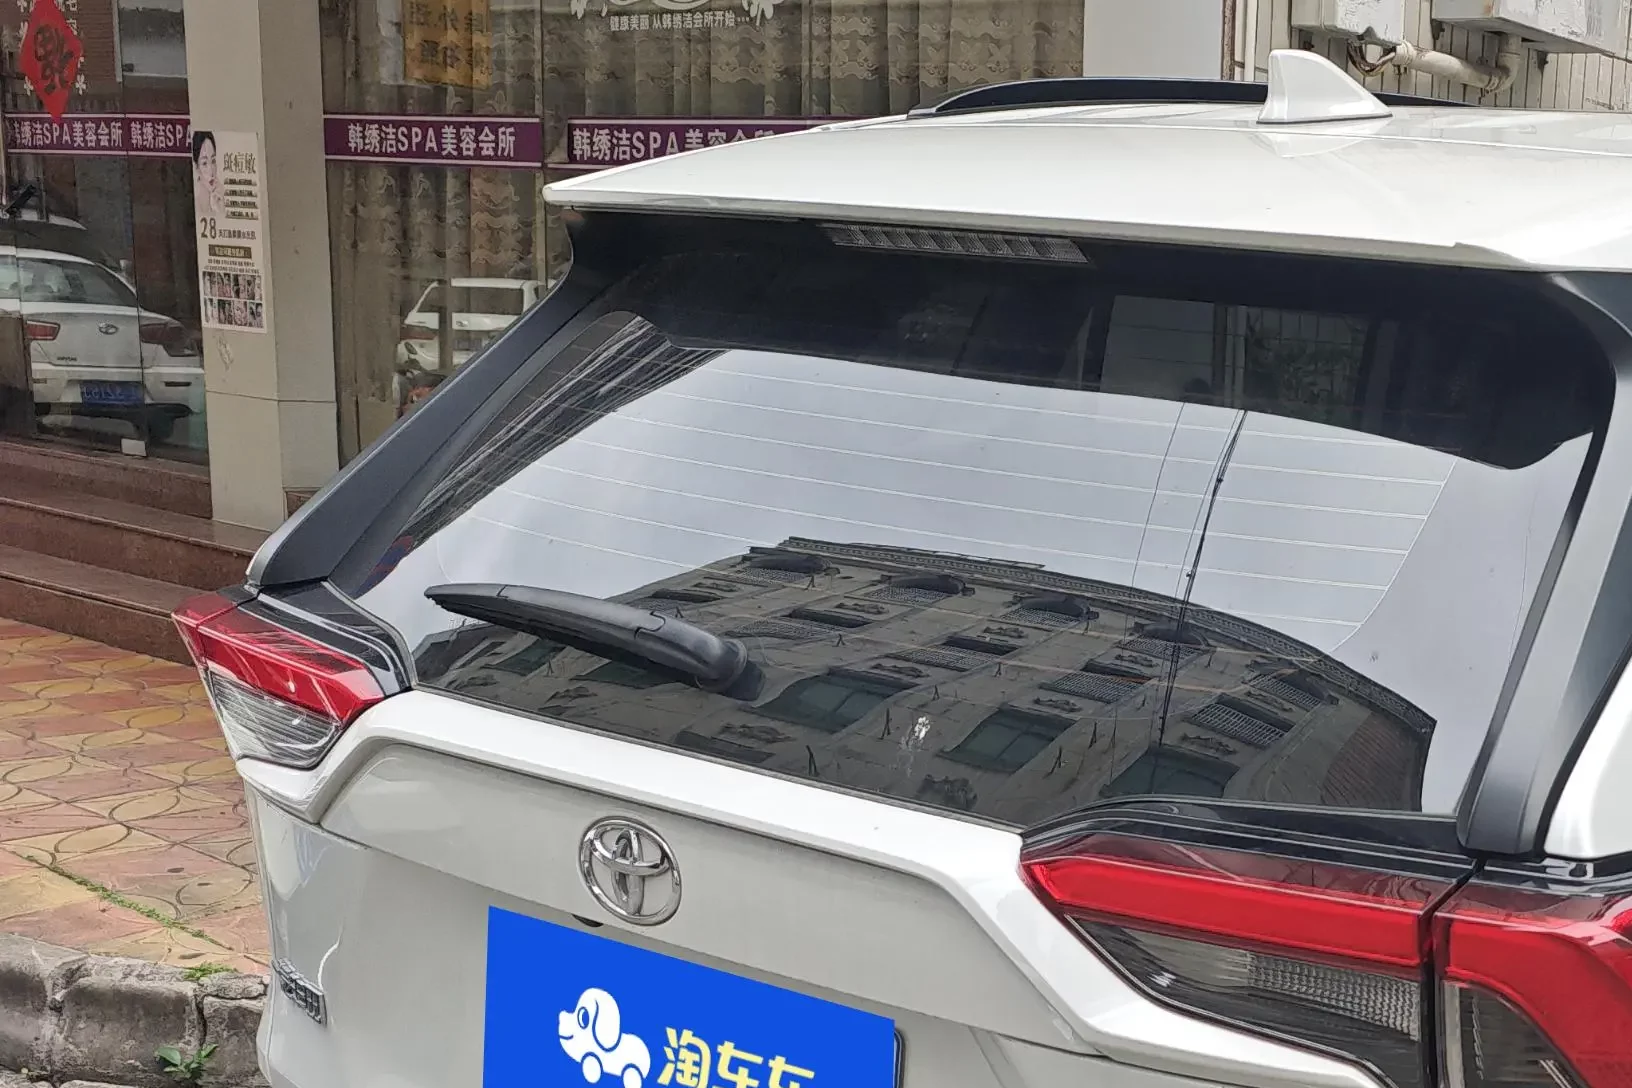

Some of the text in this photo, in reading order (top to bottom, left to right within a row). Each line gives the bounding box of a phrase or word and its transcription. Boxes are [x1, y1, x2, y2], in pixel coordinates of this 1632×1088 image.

[347, 123, 516, 158] 韩绣洁SPA美容会所
[573, 128, 775, 161] 韩绣洁SPA美
[200, 217, 217, 239] 28
